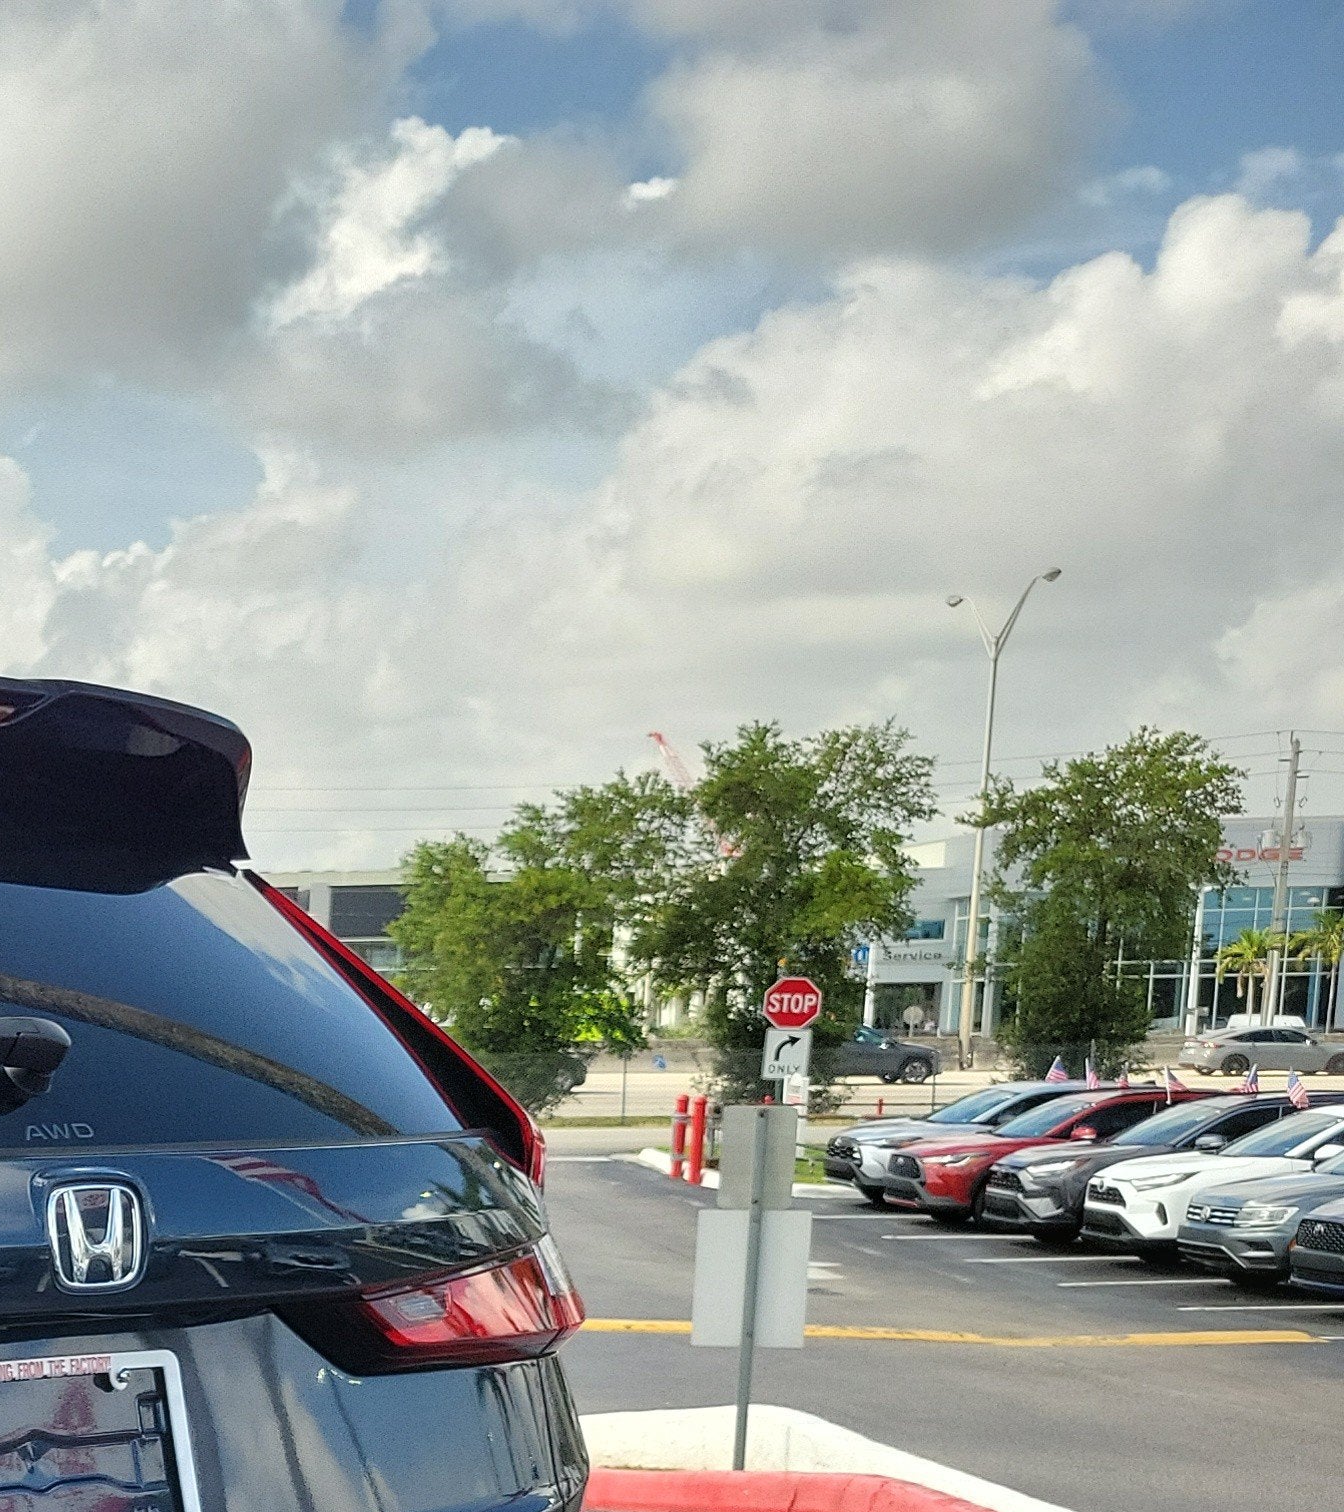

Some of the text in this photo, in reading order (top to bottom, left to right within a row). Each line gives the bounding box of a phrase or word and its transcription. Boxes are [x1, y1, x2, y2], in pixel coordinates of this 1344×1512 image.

[1215, 847, 1304, 861] ODGE
[883, 949, 942, 960] Service
[767, 993, 817, 1014] STOP
[768, 1064, 800, 1075] ONLY
[25, 1123, 94, 1141] AWD
[17, 1361, 44, 1379] FROM
[49, 1359, 65, 1375] THE
